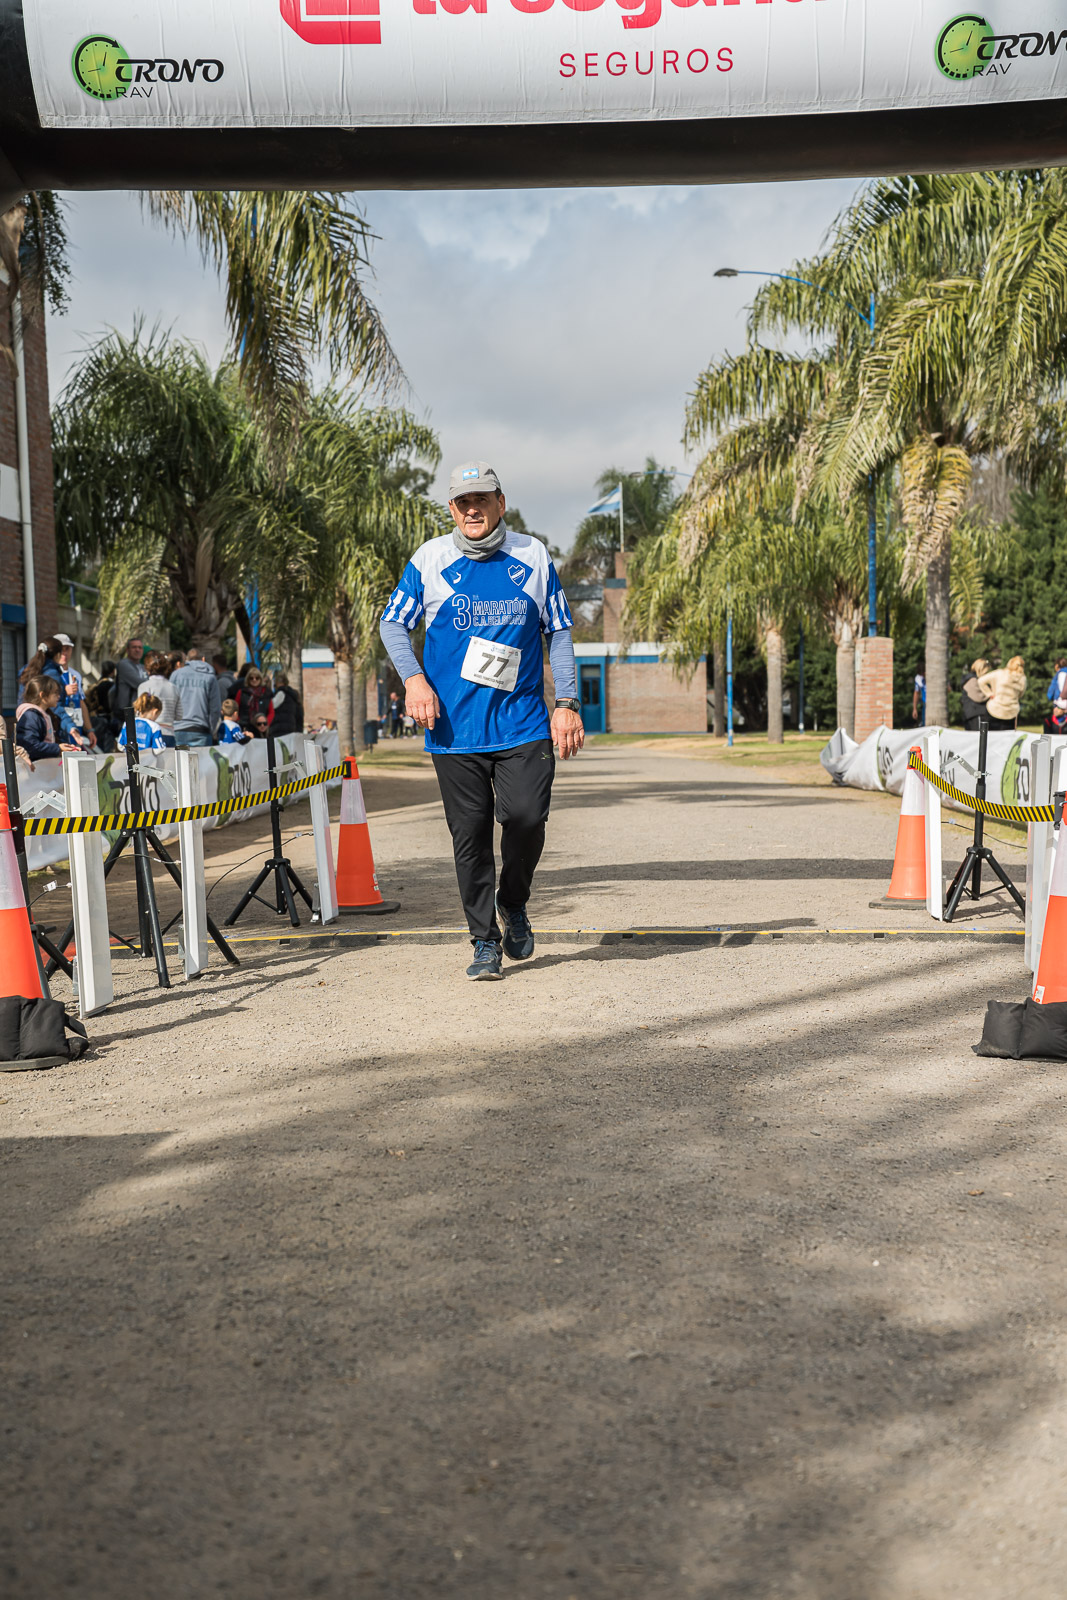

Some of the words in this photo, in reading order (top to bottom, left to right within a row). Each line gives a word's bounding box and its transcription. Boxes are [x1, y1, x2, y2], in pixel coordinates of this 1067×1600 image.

[977, 30, 1067, 60] CRON
[115, 58, 224, 83] CRONO
[559, 47, 733, 78] SEGUROS
[972, 63, 1012, 77] RAV
[115, 86, 153, 98] RAV
[452, 594, 471, 631] 3
[472, 597, 528, 616] MARATÓN
[478, 652, 510, 678] 77
